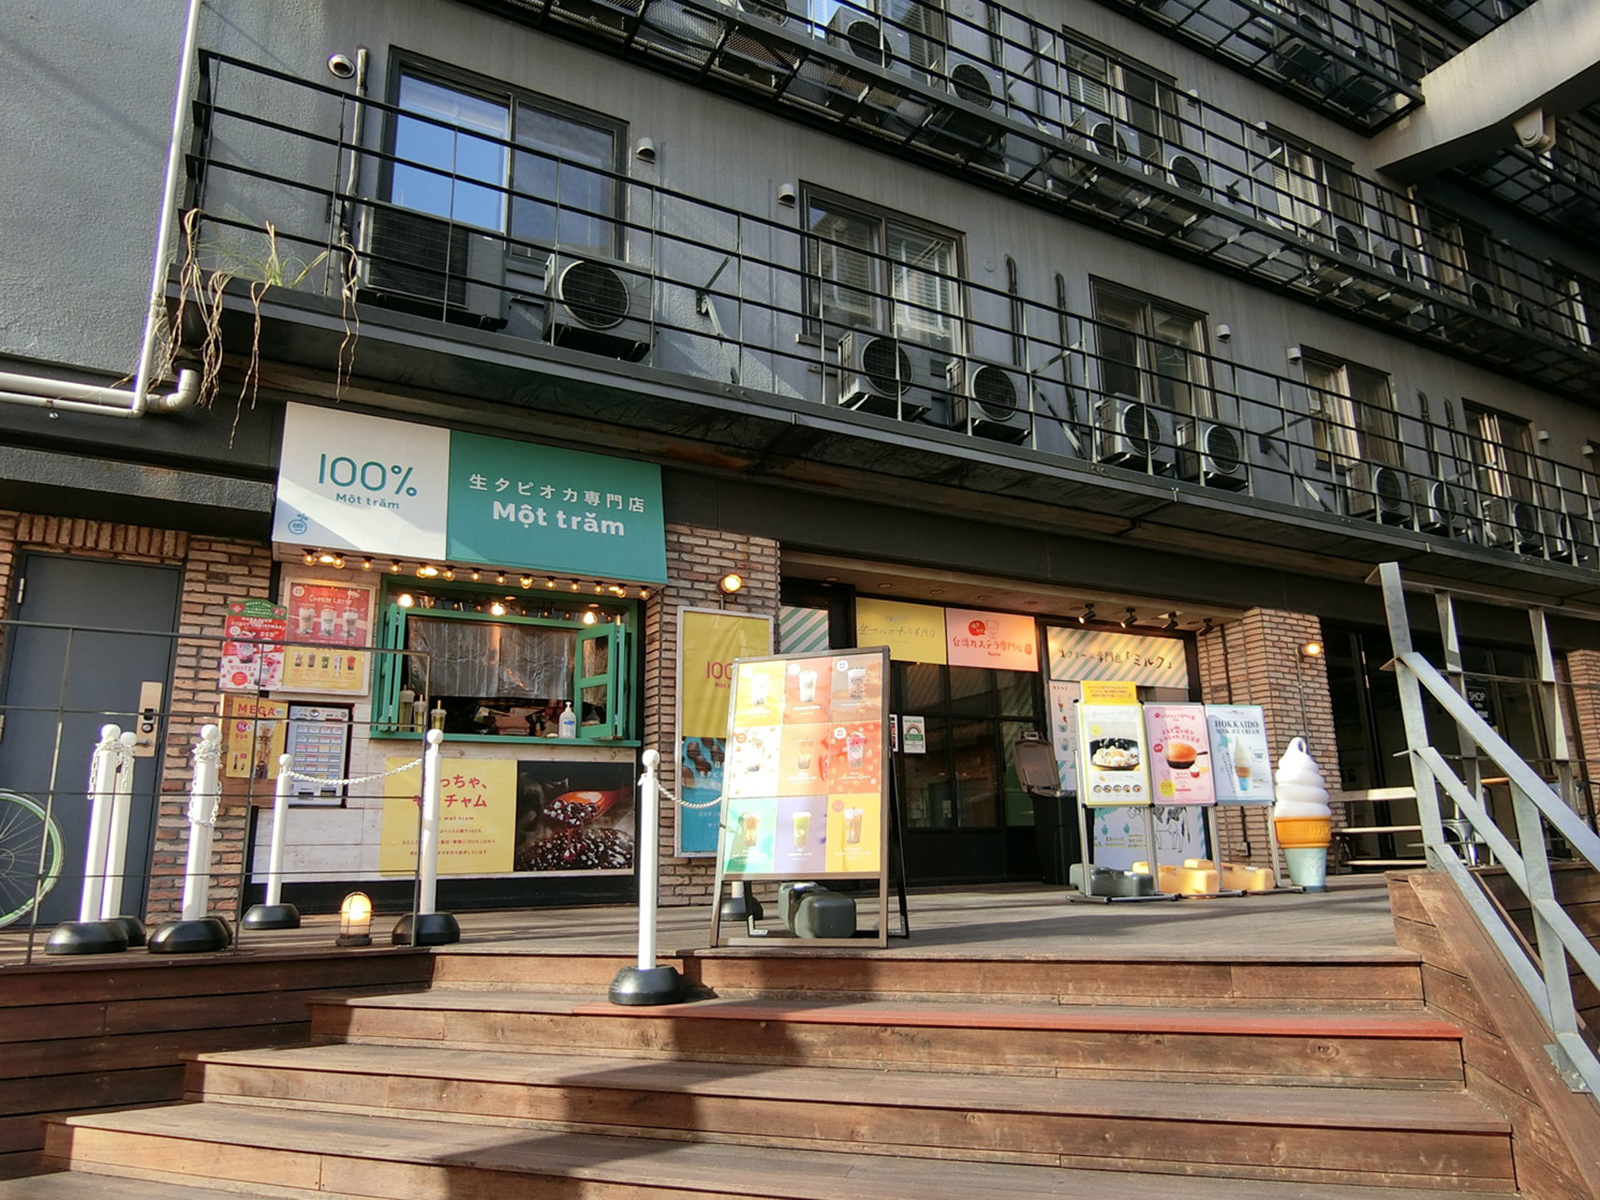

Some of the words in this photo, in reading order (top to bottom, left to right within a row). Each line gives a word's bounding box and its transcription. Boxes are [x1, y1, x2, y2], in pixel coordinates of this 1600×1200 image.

[318, 453, 418, 497] 100%
[468, 473, 645, 514] 生タピオカ専門店
[492, 500, 548, 529] Một
[556, 509, 625, 537] trăm
[237, 703, 275, 716] MEGA
[1214, 720, 1260, 729] HOKKAIDO
[440, 774, 488, 789] っちゃ、
